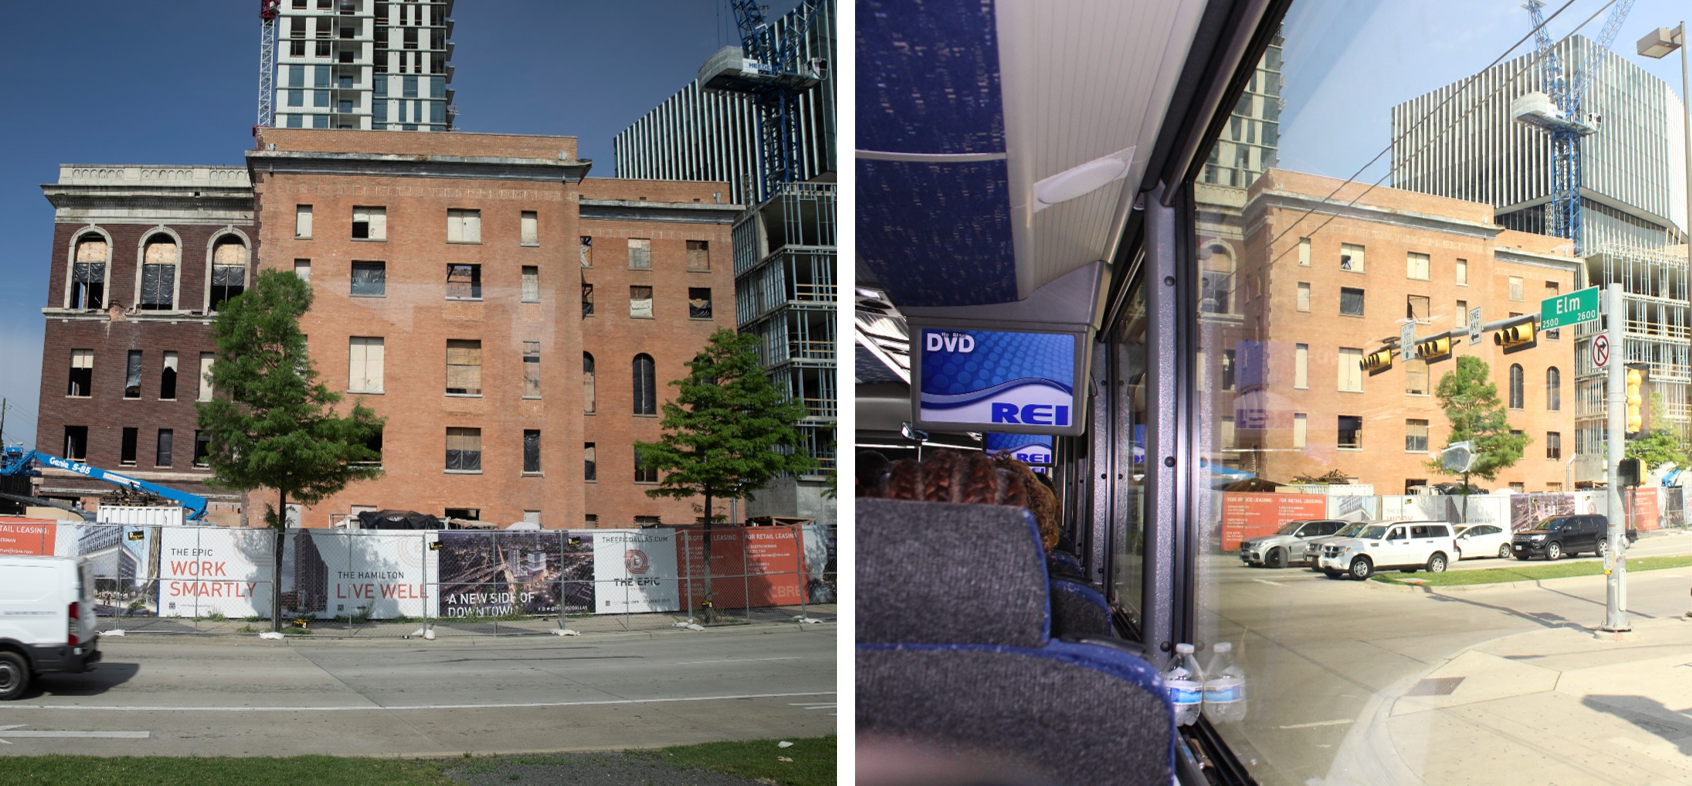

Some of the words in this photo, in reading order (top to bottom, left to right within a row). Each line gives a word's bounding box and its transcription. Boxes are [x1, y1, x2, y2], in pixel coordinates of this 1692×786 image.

[1556, 296, 1580, 315] Elm
[1470, 310, 1480, 322] ONE
[1542, 317, 1559, 328] 2500
[1577, 309, 1596, 321] 2600
[927, 333, 975, 353] DVD
[992, 402, 1069, 426] REI
[49, 457, 69, 469] Genie
[72, 463, 91, 474] S-85
[1016, 453, 1050, 463] REI
[171, 548, 189, 556] THE
[192, 548, 213, 557] EPIC
[170, 560, 226, 577] WORK
[338, 571, 355, 579] THE
[358, 571, 404, 579] HAMILTON
[614, 577, 633, 586] THE
[637, 576, 660, 586] EPIC
[170, 581, 257, 598] SMARTLY
[337, 583, 375, 599] LIVE
[379, 583, 429, 599] WELL
[448, 594, 457, 605] A
[460, 593, 488, 604] NEW
[520, 592, 535, 602] OF
